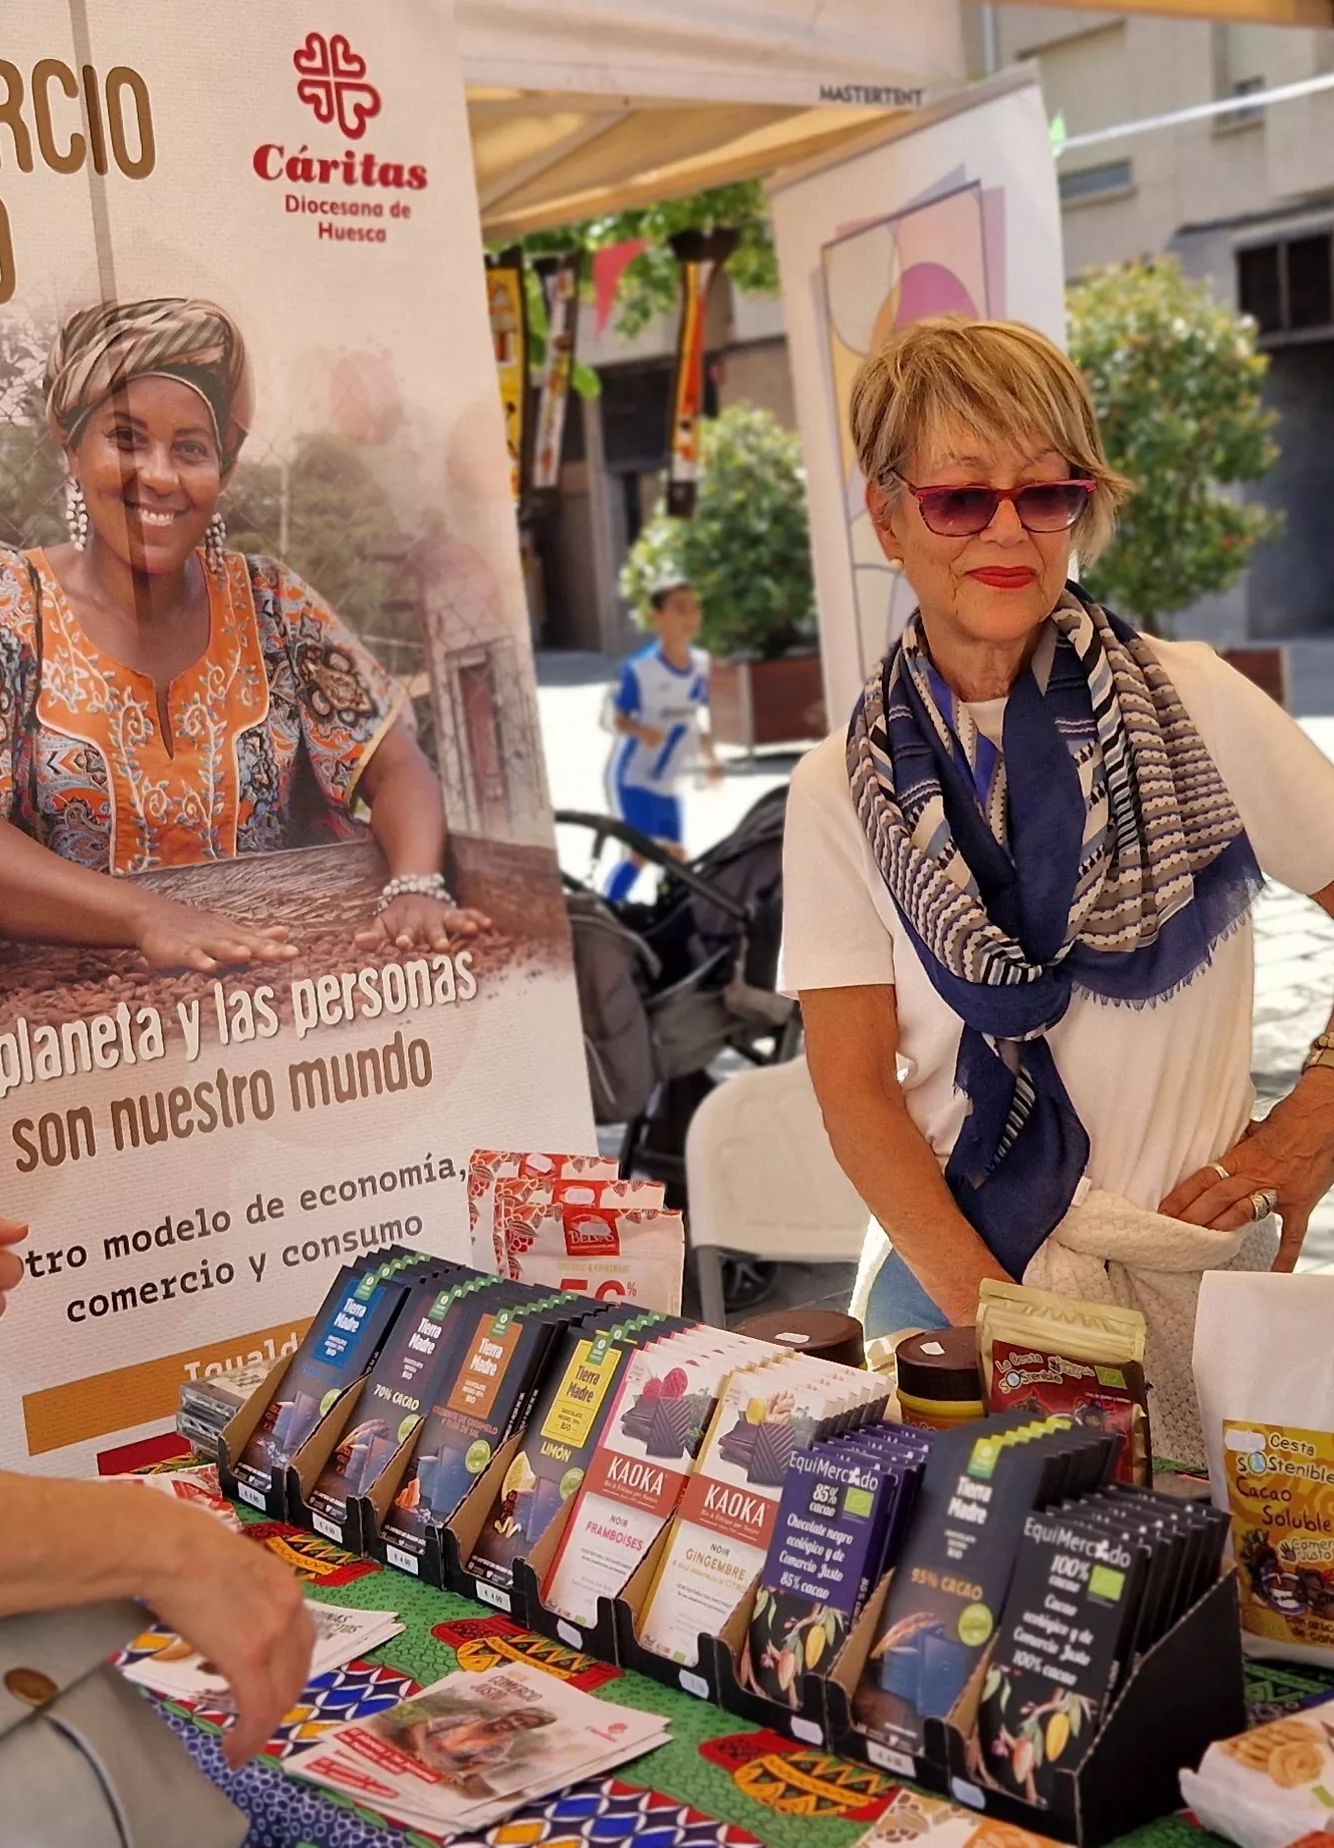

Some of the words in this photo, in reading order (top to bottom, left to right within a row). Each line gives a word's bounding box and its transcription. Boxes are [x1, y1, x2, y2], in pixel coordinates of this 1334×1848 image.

[819, 84, 923, 107] MASTERTENT
[253, 143, 428, 190] Cáritas
[285, 194, 383, 217] Diocesana
[390, 201, 411, 218] de
[319, 221, 386, 242] Huesca
[176, 998, 201, 1062] y
[214, 981, 279, 1046] las
[291, 948, 478, 1040] personas
[11, 1106, 96, 1172] son
[110, 1064, 276, 1151] nuestro
[288, 1031, 433, 1112] mundo
[16, 1239, 88, 1281] tro
[103, 1208, 231, 1261] modelo
[245, 1193, 285, 1227] de
[300, 1151, 469, 1211] economía,
[65, 1263, 235, 1323] comercio
[248, 1252, 267, 1282] y
[281, 1215, 424, 1268] consumo
[417, 1317, 443, 1339] Tierra
[408, 1332, 436, 1355] Madre
[478, 1338, 503, 1360] Tierra
[470, 1354, 498, 1376] Madre
[575, 1365, 602, 1386] Tierra
[373, 1384, 392, 1401] 70%
[392, 1391, 420, 1411] CACAO
[566, 1382, 595, 1404] Madre
[540, 1441, 571, 1463] LIMÓN
[1270, 1434, 1315, 1457] Cesta
[606, 1456, 665, 1496] KAOKA
[1235, 1476, 1292, 1501] Cacao
[812, 1483, 839, 1505] 85%
[956, 1476, 993, 1503] Tierra
[704, 1483, 765, 1527] KAOKA
[809, 1501, 836, 1517] cacao
[947, 1497, 988, 1525] Madre
[609, 1515, 629, 1527] NOIR
[787, 1513, 825, 1537] Chocolate
[826, 1527, 854, 1545] negro
[1262, 1504, 1332, 1532] Soluble
[585, 1521, 644, 1551] FRAMBOISES
[710, 1543, 730, 1556] NOIR
[825, 1549, 832, 1562] y
[832, 1550, 846, 1562] de
[1297, 1550, 1333, 1561] Justo
[685, 1549, 746, 1581] GINGEMBRE
[779, 1550, 817, 1573] Comercio
[817, 1563, 843, 1582] Justo
[1051, 1555, 1090, 1581] 100%
[780, 1572, 800, 1590] 85%
[801, 1580, 830, 1600] cacao
[941, 1577, 983, 1602] CACAO
[1044, 1593, 1078, 1617] Cacao
[1013, 1627, 1059, 1654] Comercio
[1059, 1646, 1092, 1666] Justo
[1078, 1628, 1094, 1645] de
[1013, 1650, 1042, 1672] 100%
[1043, 1663, 1078, 1686] cacao
